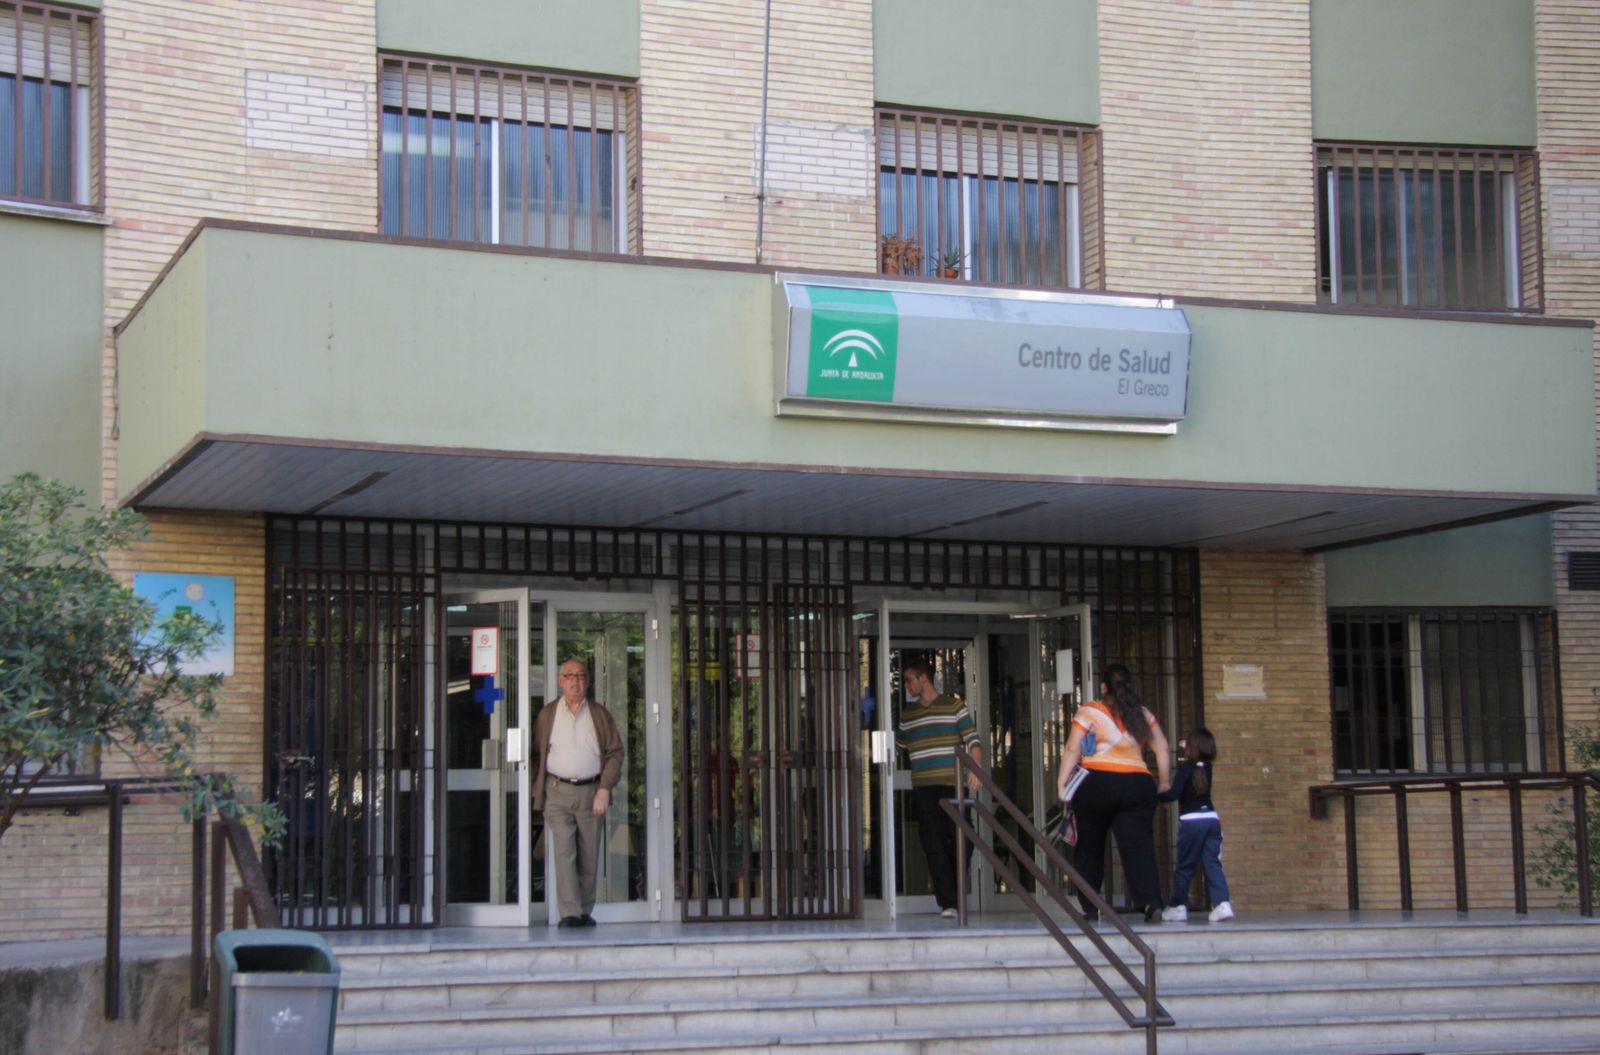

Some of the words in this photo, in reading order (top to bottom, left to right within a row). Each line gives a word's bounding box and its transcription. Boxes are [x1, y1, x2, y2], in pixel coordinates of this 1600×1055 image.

[1018, 343, 1082, 370] Centro
[1088, 347, 1112, 372] de
[1118, 348, 1171, 375] Salud
[819, 368, 839, 379] JUNTA
[842, 369, 849, 379] DE
[1118, 378, 1129, 395] El
[1134, 379, 1169, 397] Greco
